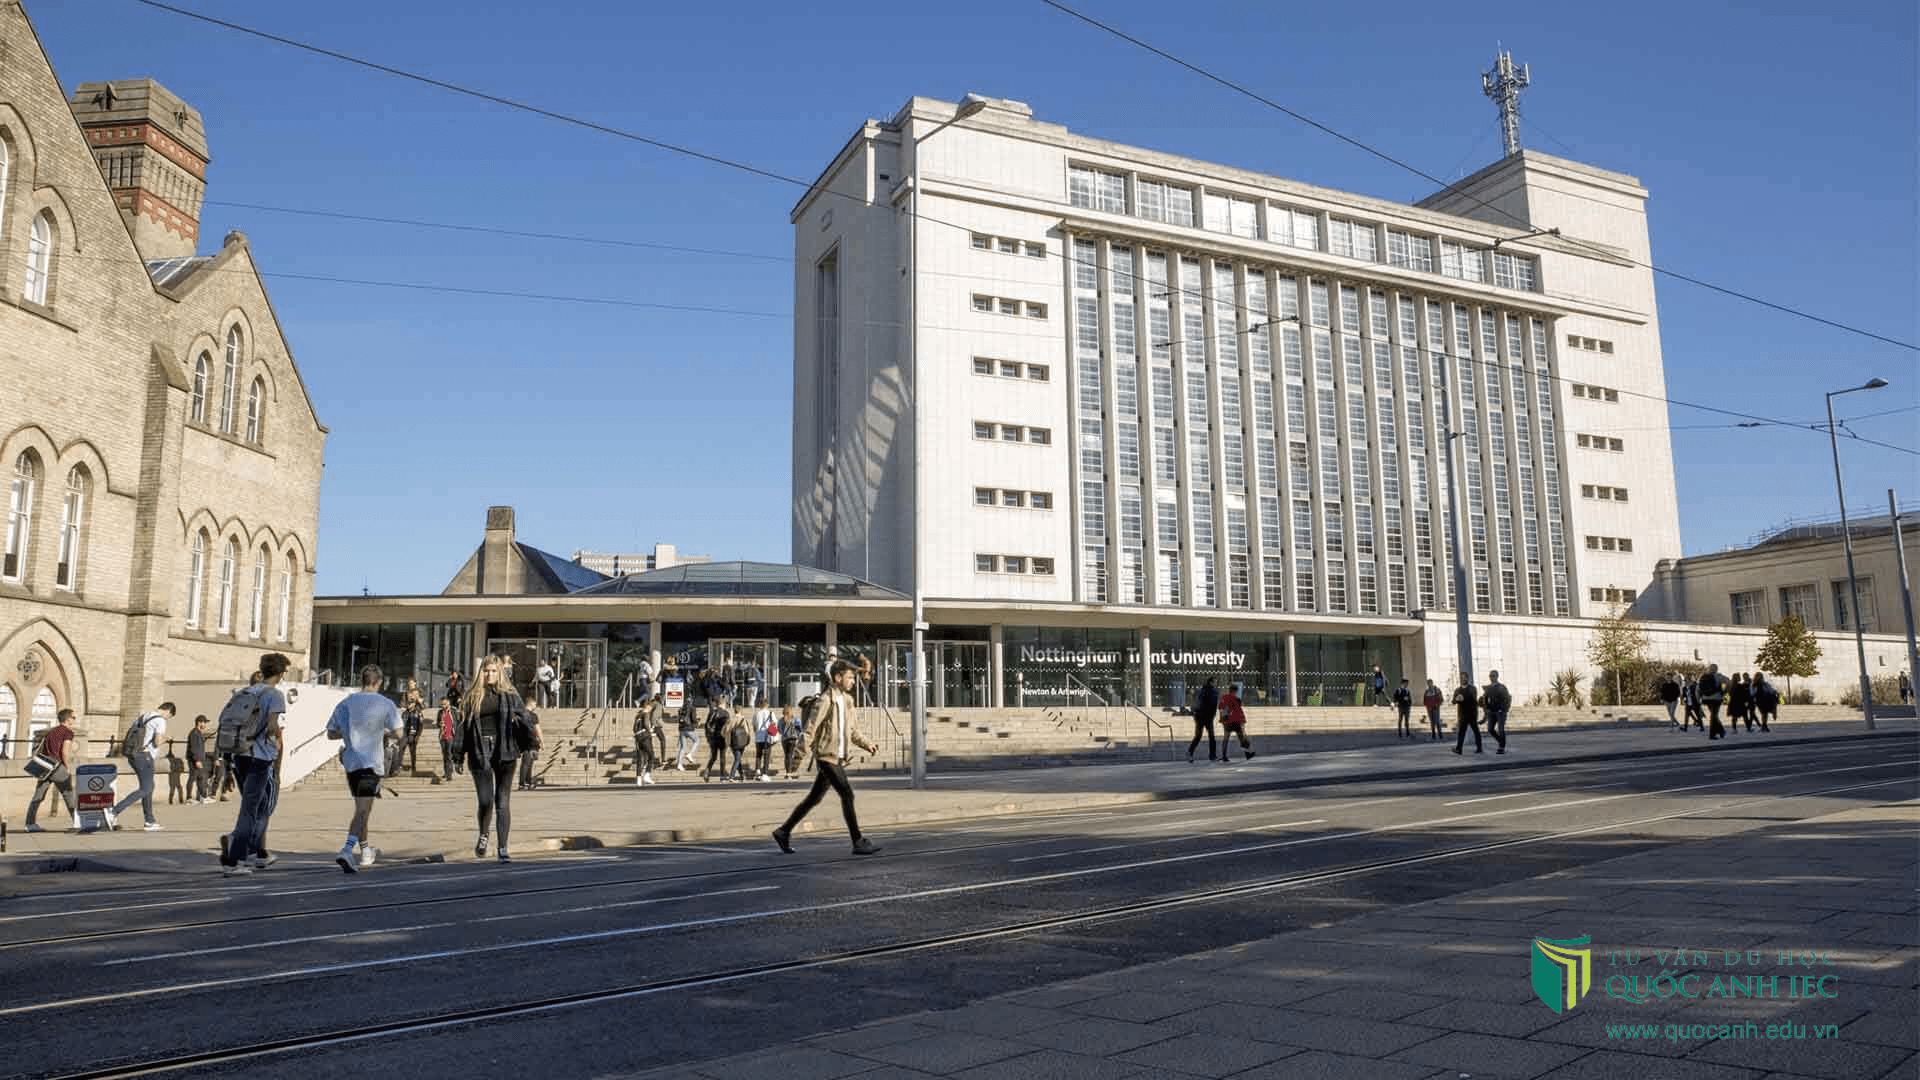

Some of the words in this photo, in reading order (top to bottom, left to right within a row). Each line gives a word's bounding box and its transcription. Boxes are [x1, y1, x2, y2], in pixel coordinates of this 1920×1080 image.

[1020, 645, 1122, 667] Nottingham
[1126, 647, 1168, 664] Trnt
[1170, 648, 1245, 669] University
[1022, 687, 1050, 696] Newton
